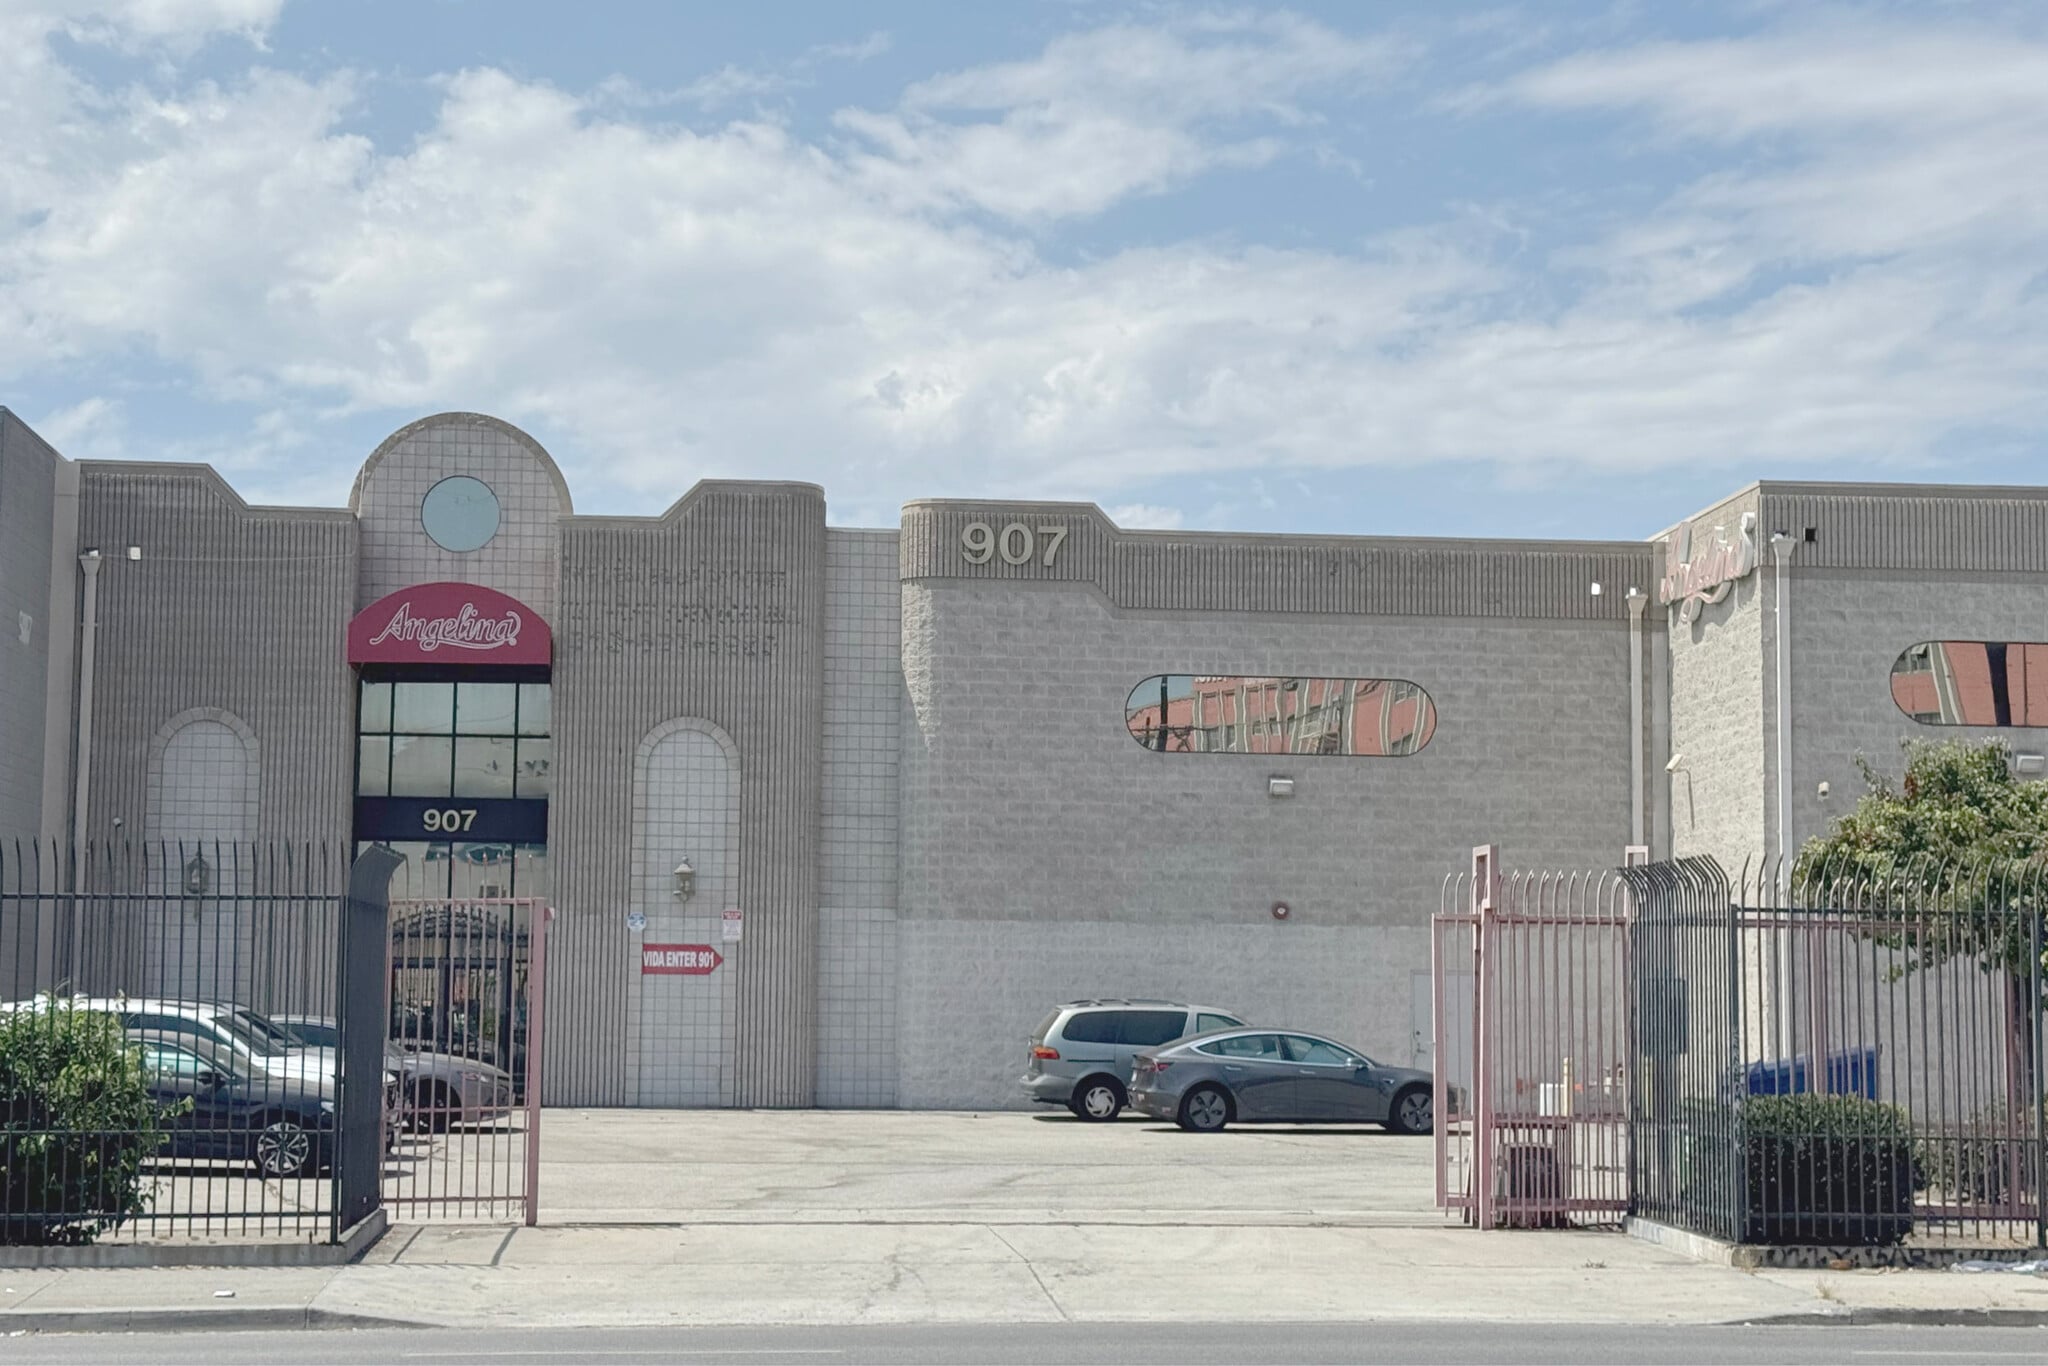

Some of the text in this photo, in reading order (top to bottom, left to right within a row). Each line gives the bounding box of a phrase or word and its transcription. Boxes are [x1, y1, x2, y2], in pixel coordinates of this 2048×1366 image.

[961, 522, 1068, 567] 907
[369, 602, 521, 651] Angelina
[423, 808, 478, 833] 907
[643, 951, 715, 968] VIDA ENTER 901
